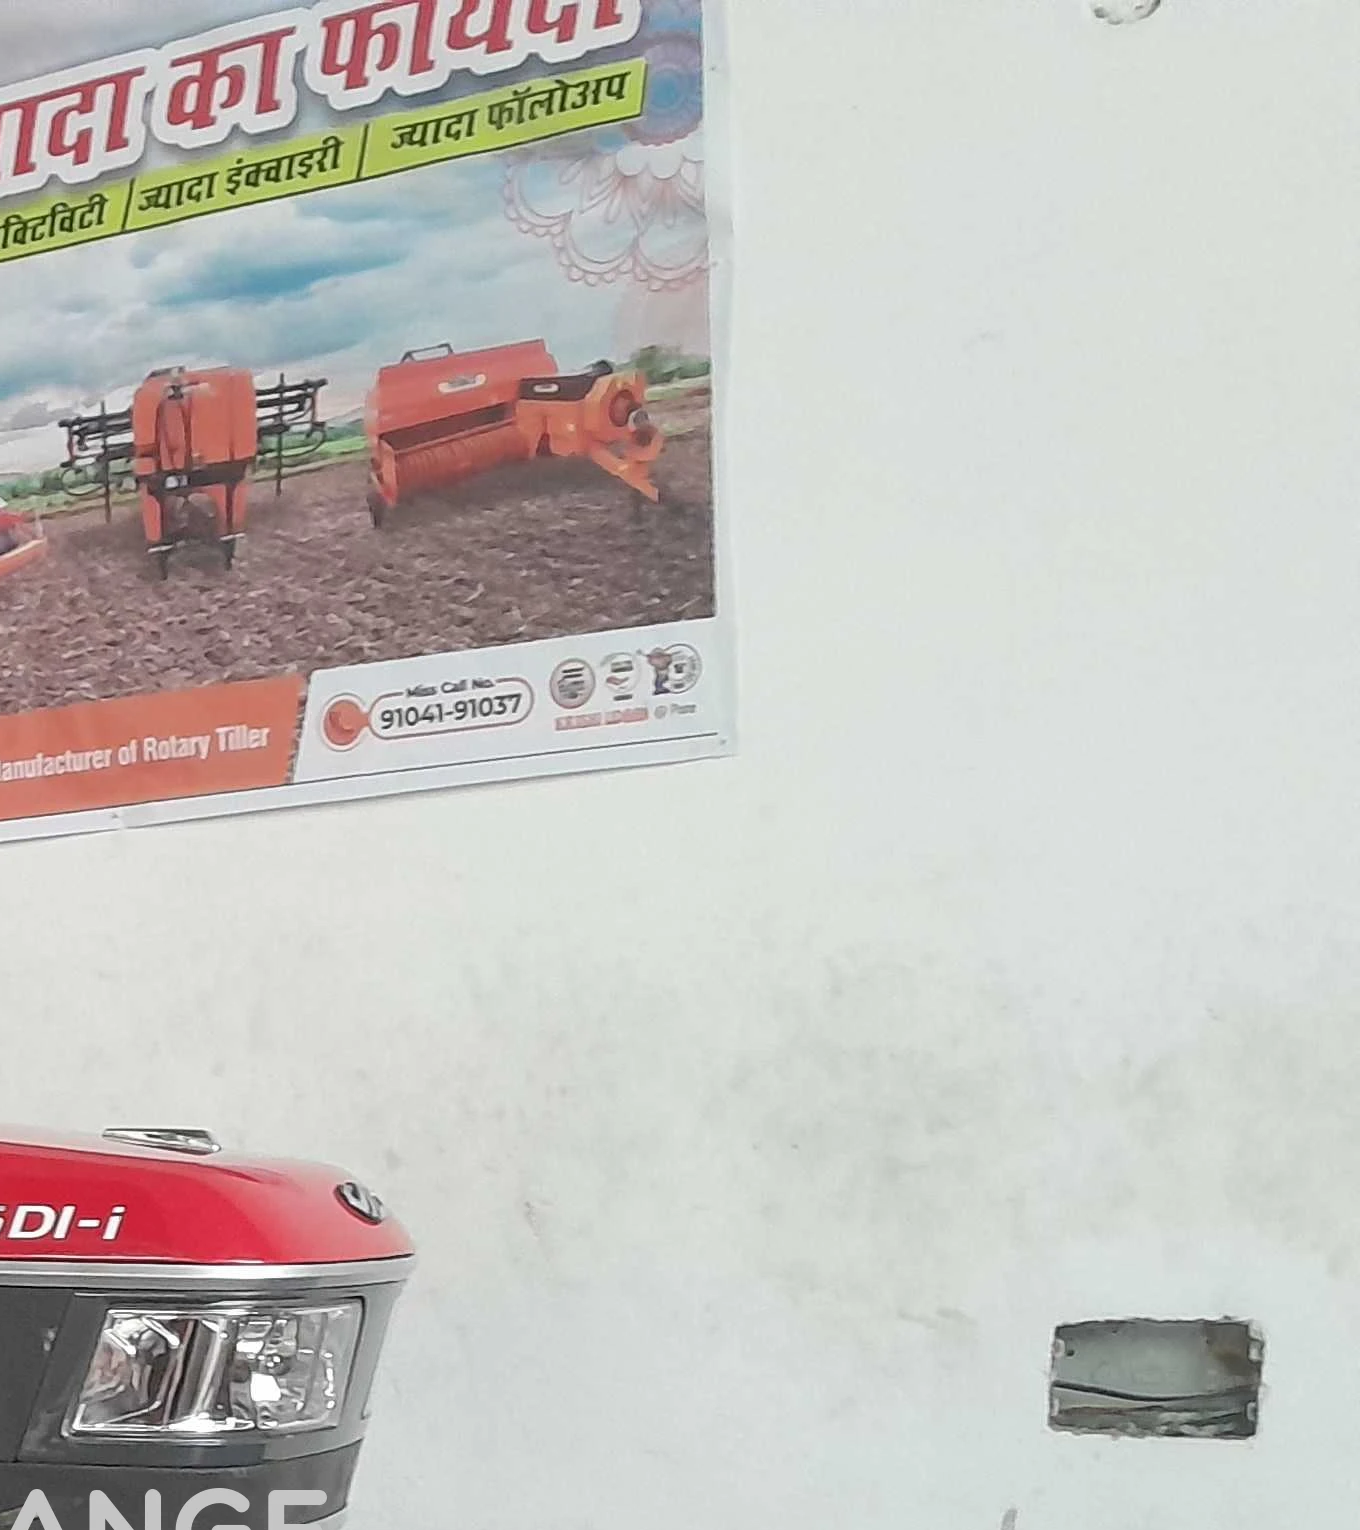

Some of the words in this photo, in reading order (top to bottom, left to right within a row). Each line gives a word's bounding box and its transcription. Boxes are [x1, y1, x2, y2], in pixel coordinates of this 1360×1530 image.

[167, 28, 295, 129] का
[137, 172, 216, 213] ज्यादा
[390, 108, 479, 150] ज्यादा
[486, 71, 632, 131] फॉलोअप
[117, 738, 138, 766] of
[143, 733, 211, 762] Rotary
[215, 723, 271, 754] Tiller
[380, 692, 523, 730] 91041-91037
